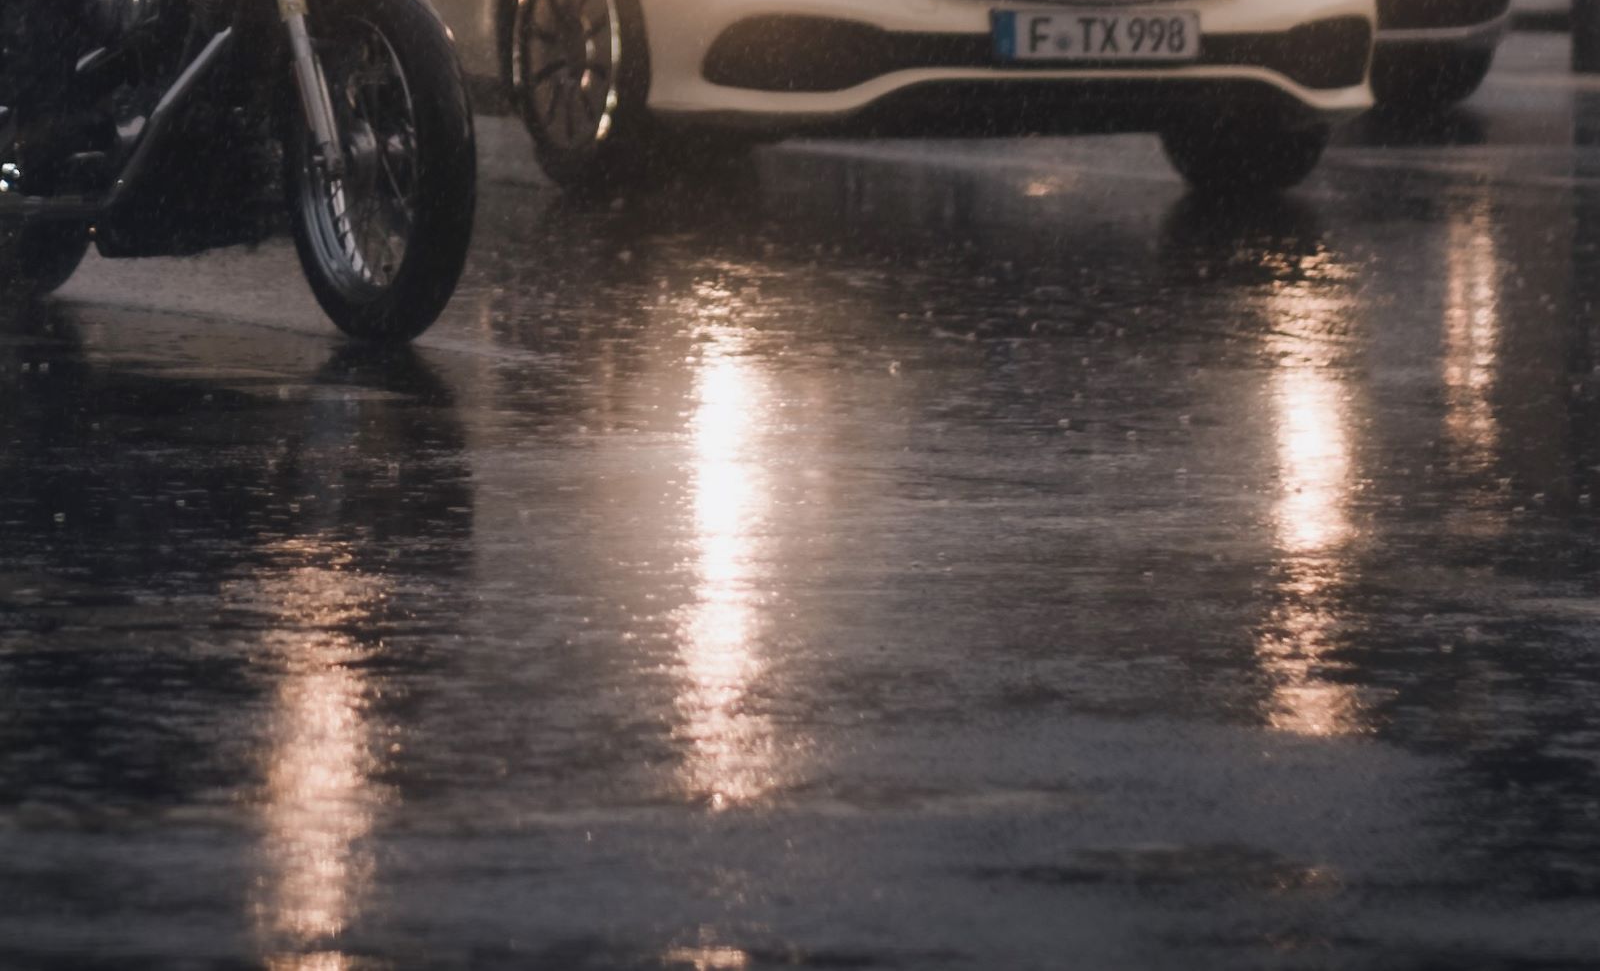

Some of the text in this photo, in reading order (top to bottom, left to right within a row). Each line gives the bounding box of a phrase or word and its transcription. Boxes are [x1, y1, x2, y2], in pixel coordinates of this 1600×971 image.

[1029, 17, 1186, 53] F TX 998
